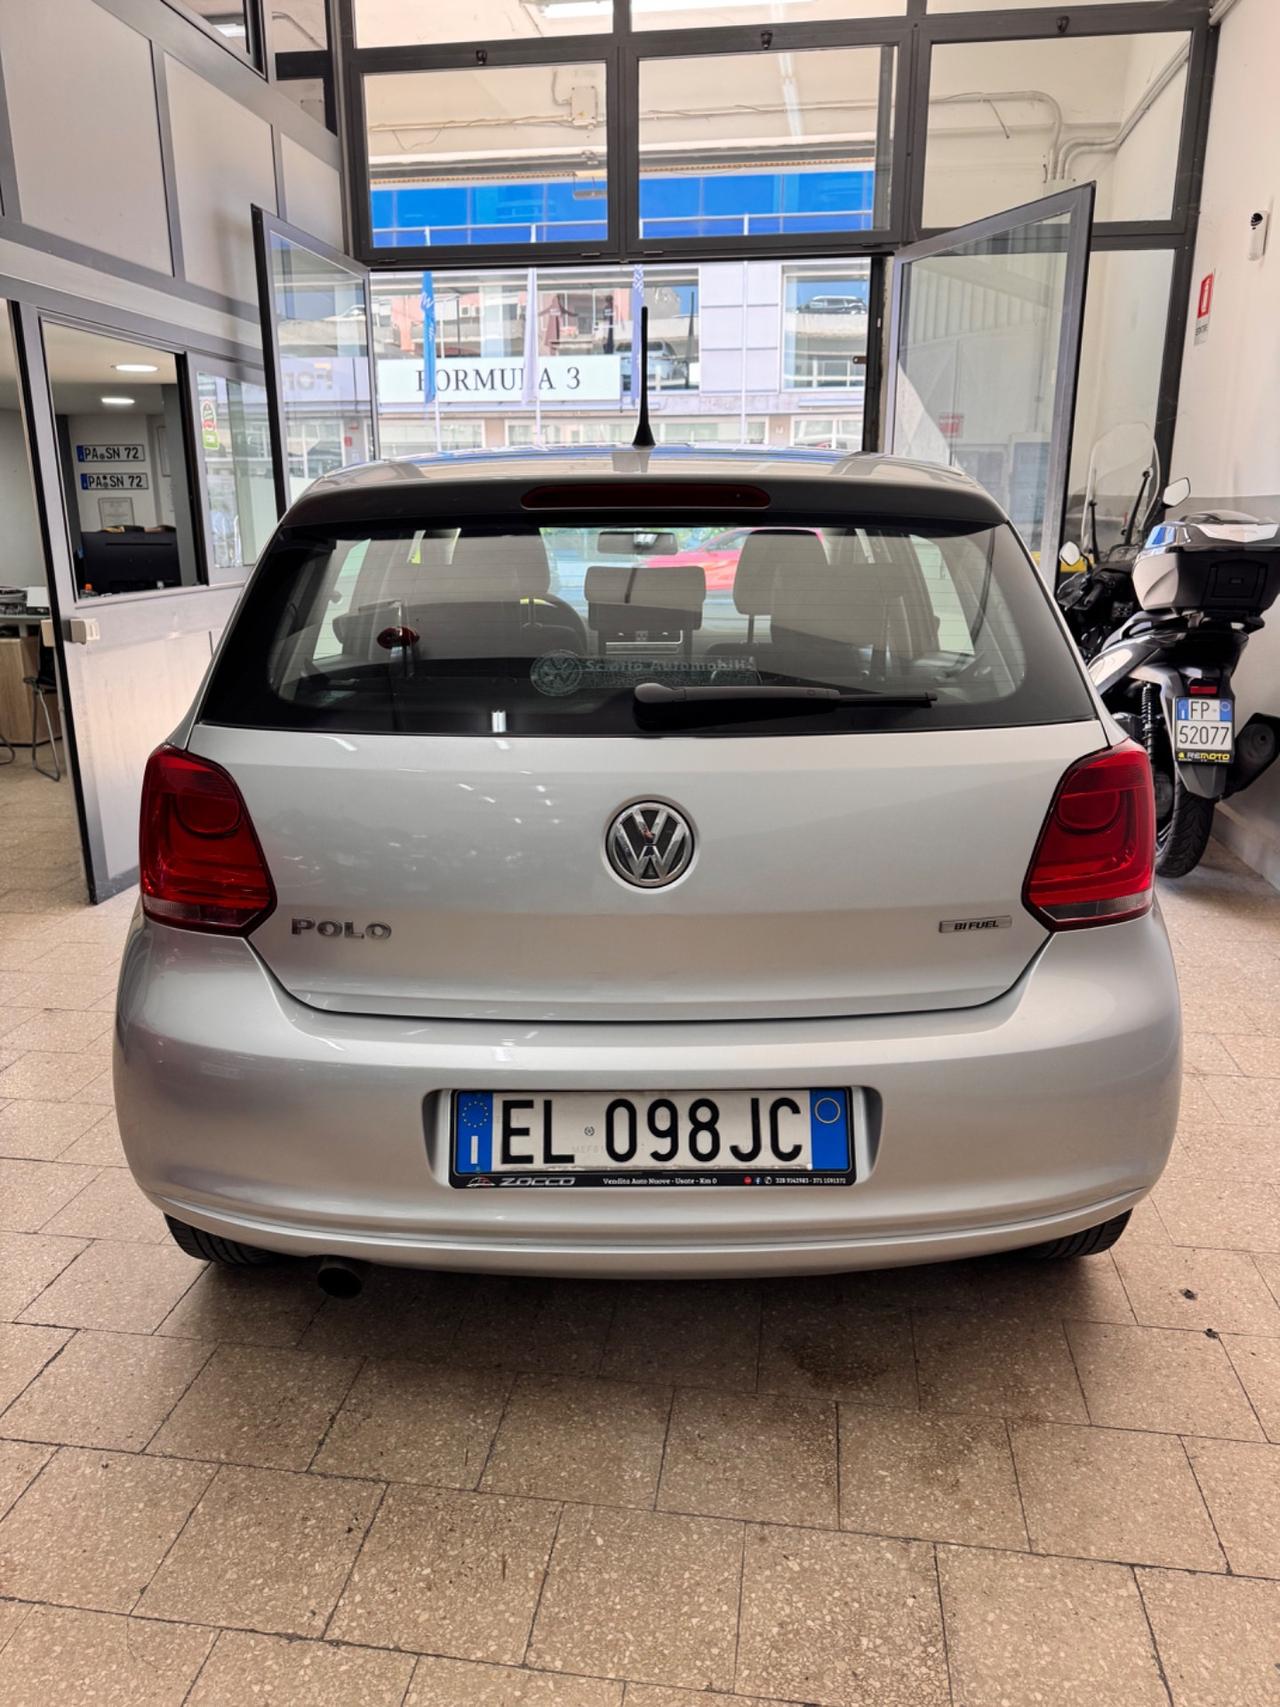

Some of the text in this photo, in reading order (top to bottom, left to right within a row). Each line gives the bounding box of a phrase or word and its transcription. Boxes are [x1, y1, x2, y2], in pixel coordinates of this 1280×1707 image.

[566, 366, 581, 390] 3
[105, 446, 121, 460] SN
[124, 446, 139, 460] 72
[109, 474, 124, 488] SN
[128, 474, 143, 488] 72
[1190, 700, 1210, 720] FP
[1179, 724, 1230, 746] 52077
[290, 918, 392, 940] POLO
[501, 1099, 575, 1165] EL
[605, 1097, 803, 1163] 098JC
[500, 1176, 576, 1186] ZOCCO
